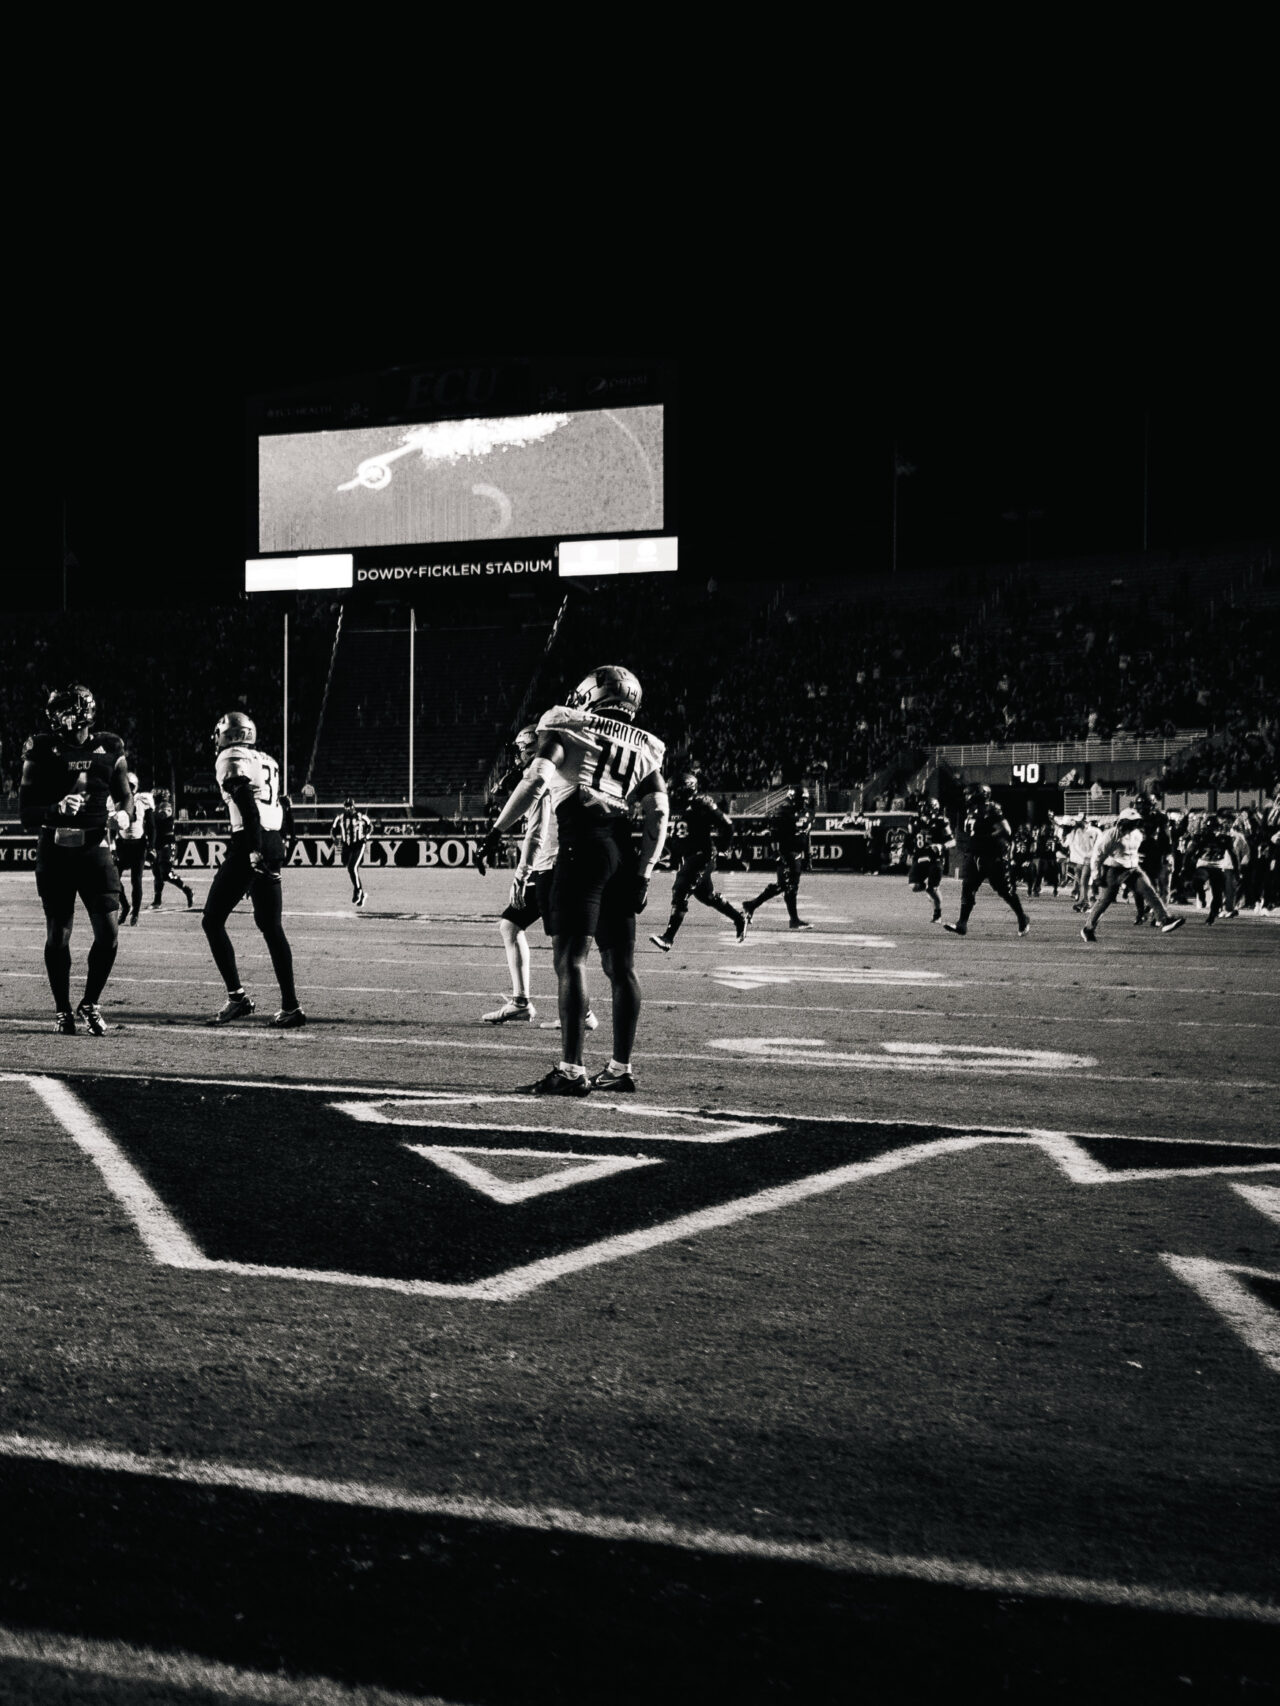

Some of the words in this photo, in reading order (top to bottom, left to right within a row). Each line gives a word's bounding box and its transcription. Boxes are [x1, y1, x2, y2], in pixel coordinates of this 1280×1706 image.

[357, 565, 480, 582] DOWDY-FICKLEN
[485, 559, 553, 576] STADIUM
[1013, 763, 1040, 785] 40
